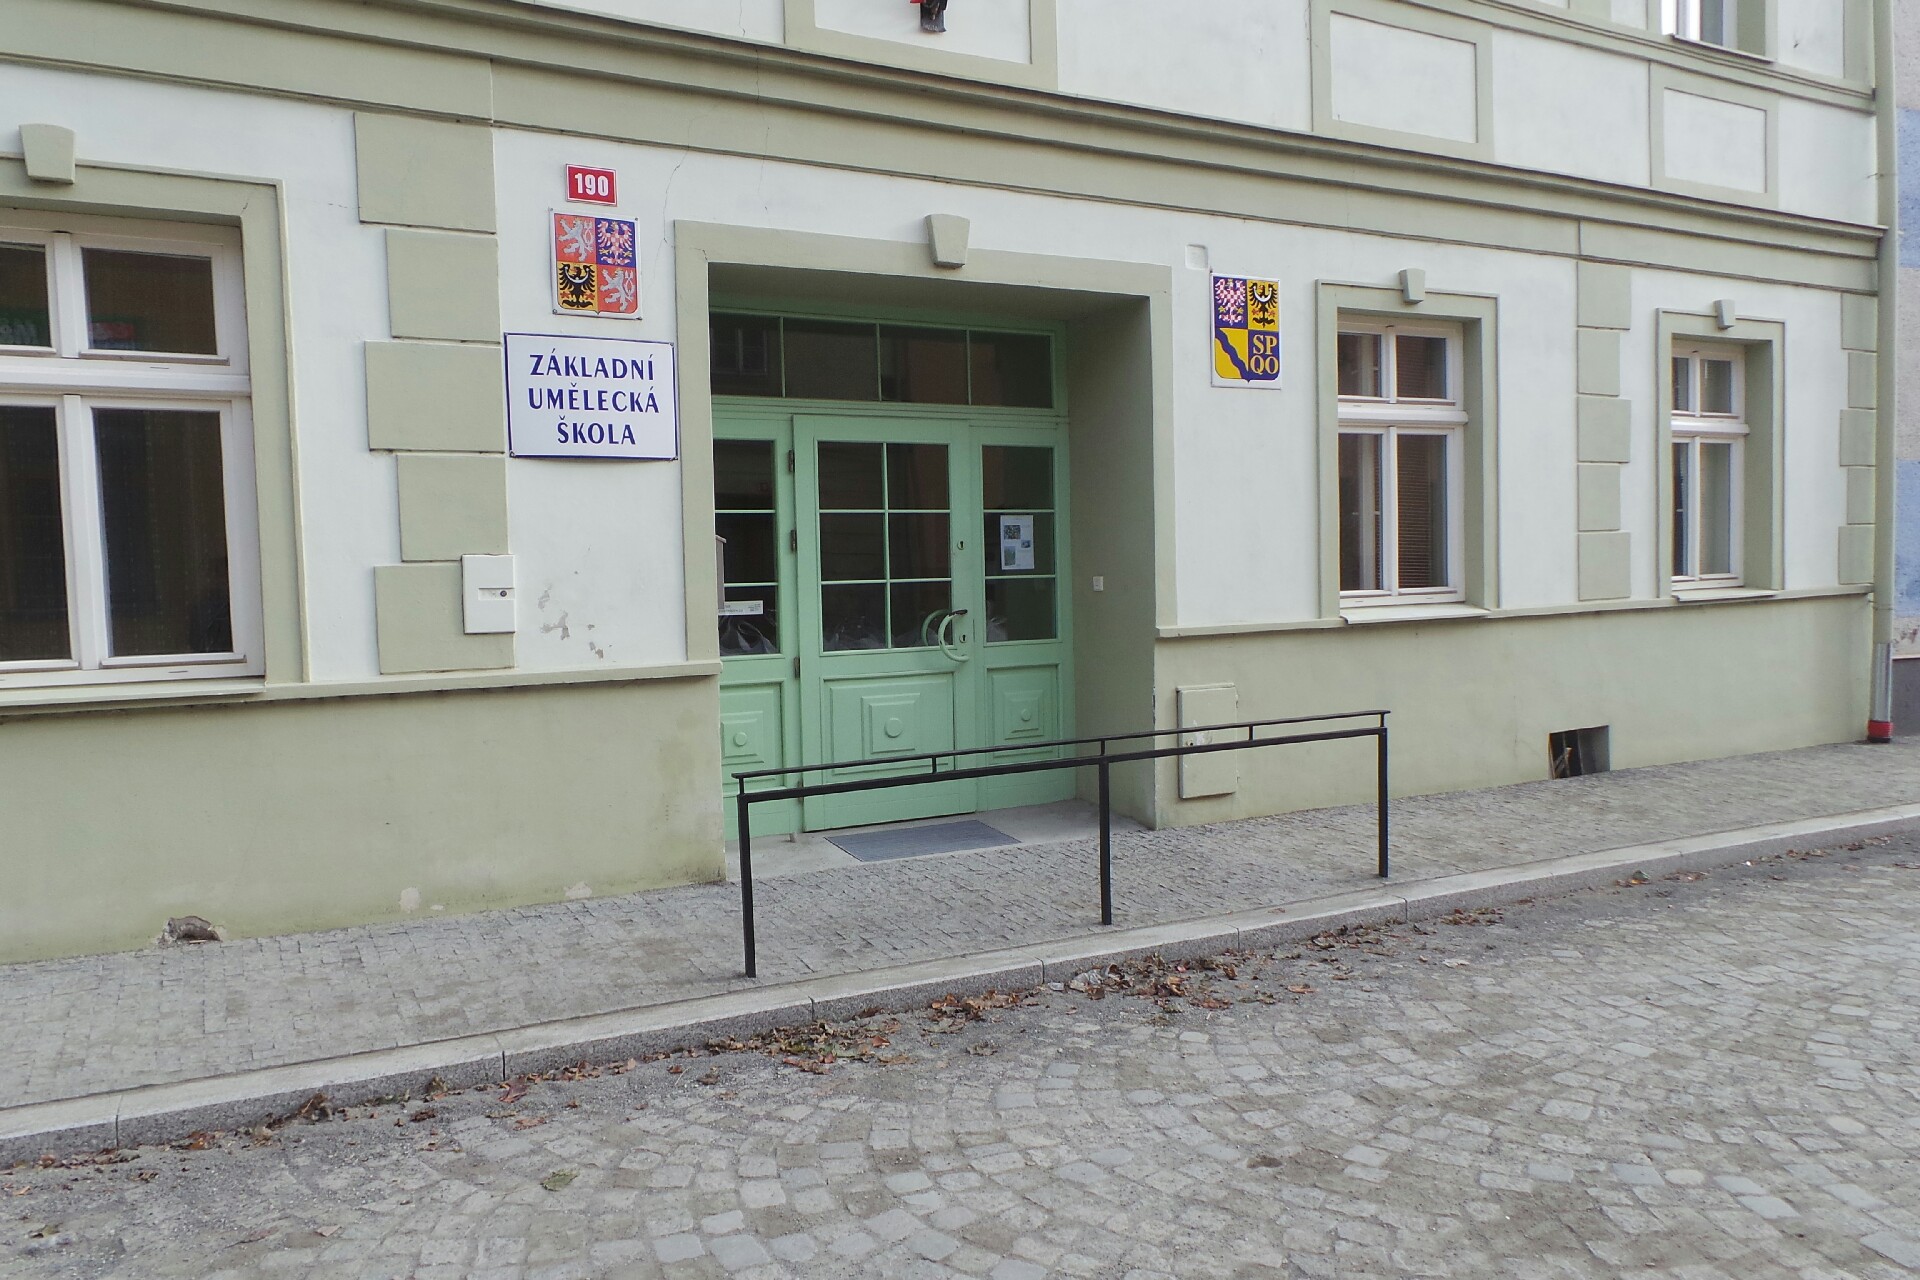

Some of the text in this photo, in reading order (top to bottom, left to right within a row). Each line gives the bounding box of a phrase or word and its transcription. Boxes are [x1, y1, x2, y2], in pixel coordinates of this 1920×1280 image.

[574, 172, 609, 197] 190
[1252, 334, 1278, 355] SP
[529, 348, 654, 381] ZÁKLADNÍ
[528, 382, 660, 414] UMĚLECKÁ
[557, 415, 636, 445] ŠKOLA
